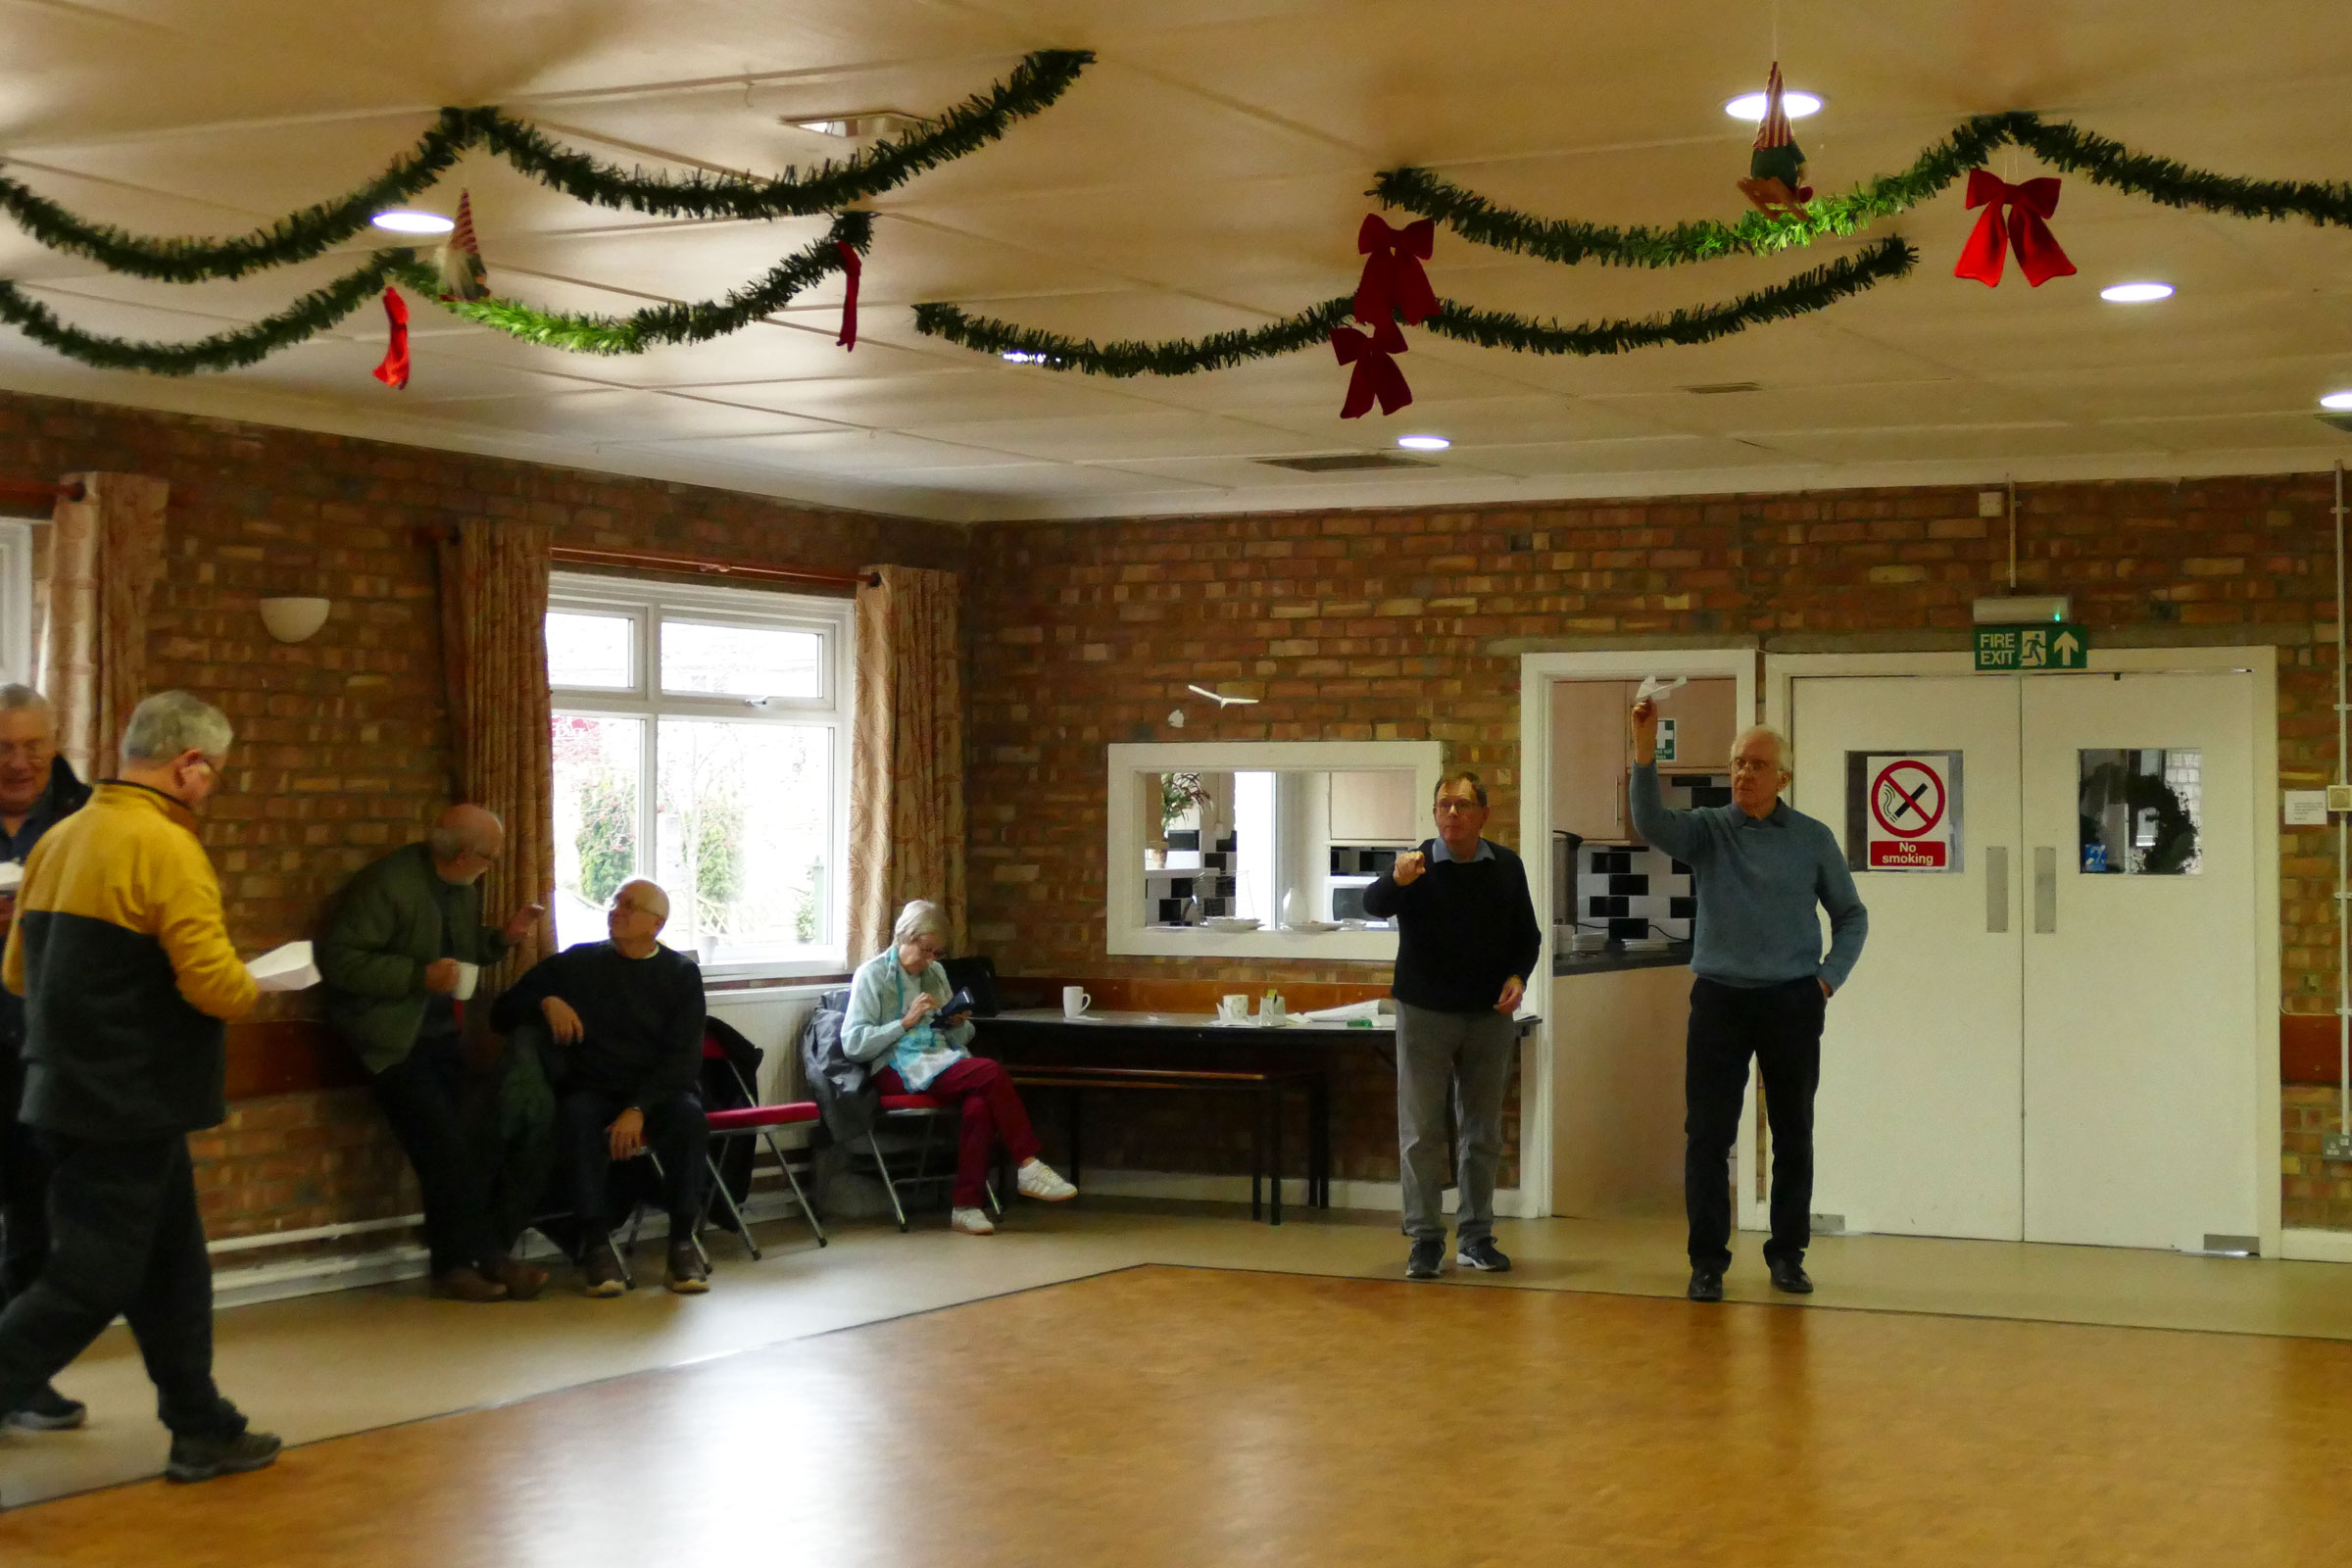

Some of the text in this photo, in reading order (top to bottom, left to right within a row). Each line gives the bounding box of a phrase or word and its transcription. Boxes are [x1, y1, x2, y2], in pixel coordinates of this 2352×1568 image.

[1980, 633, 2016, 648] FIRE
[1981, 650, 2015, 664] EXIT
[1899, 842, 1917, 853] No
[1882, 854, 1934, 866] smoking
